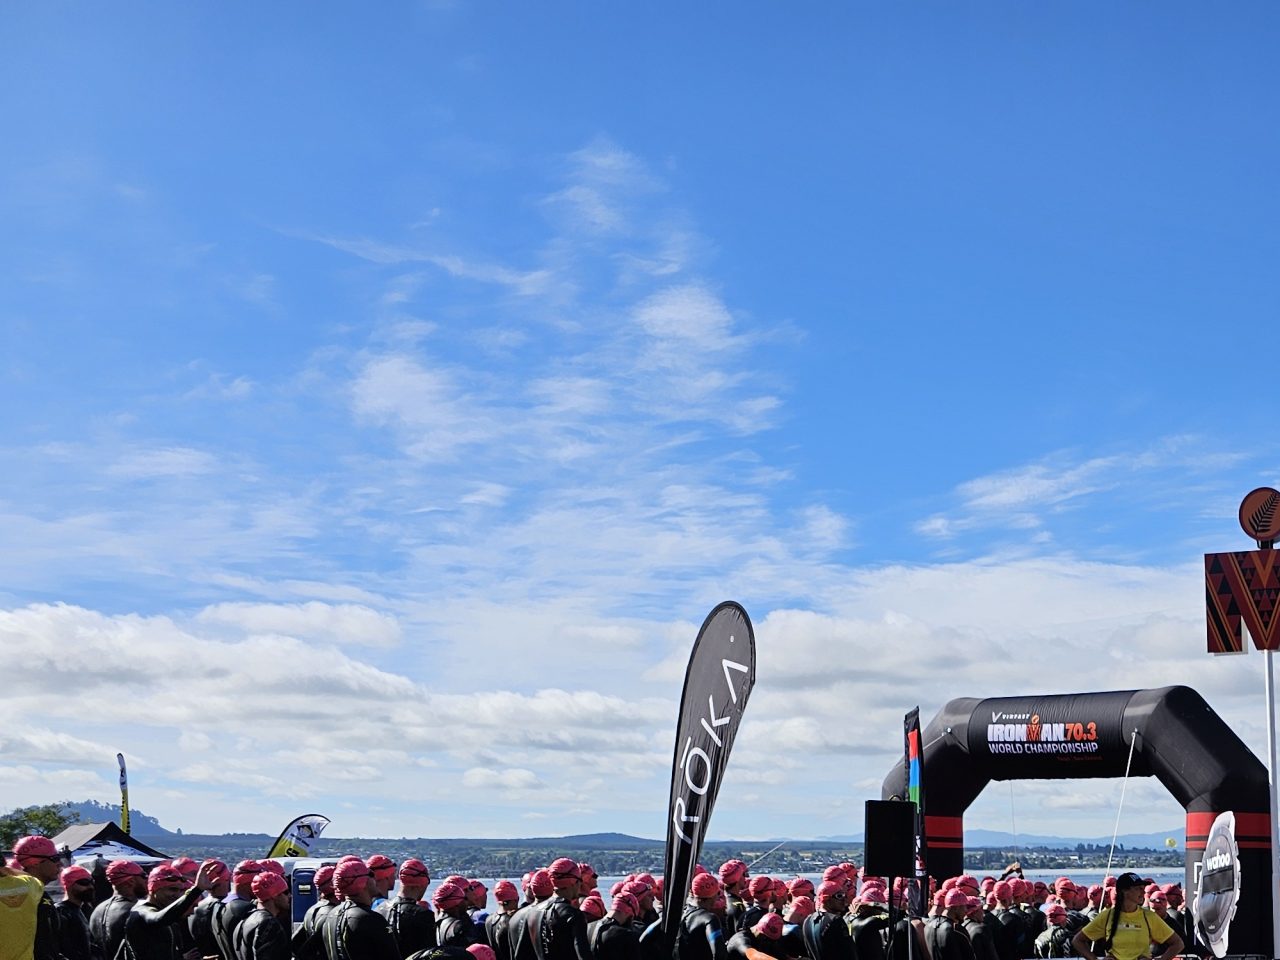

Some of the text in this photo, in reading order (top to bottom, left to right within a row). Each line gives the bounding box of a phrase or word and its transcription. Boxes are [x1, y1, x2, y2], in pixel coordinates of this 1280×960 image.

[988, 742, 1098, 754] WORLD CHAMPIONSHIP
[1207, 849, 1231, 871] wahoo
